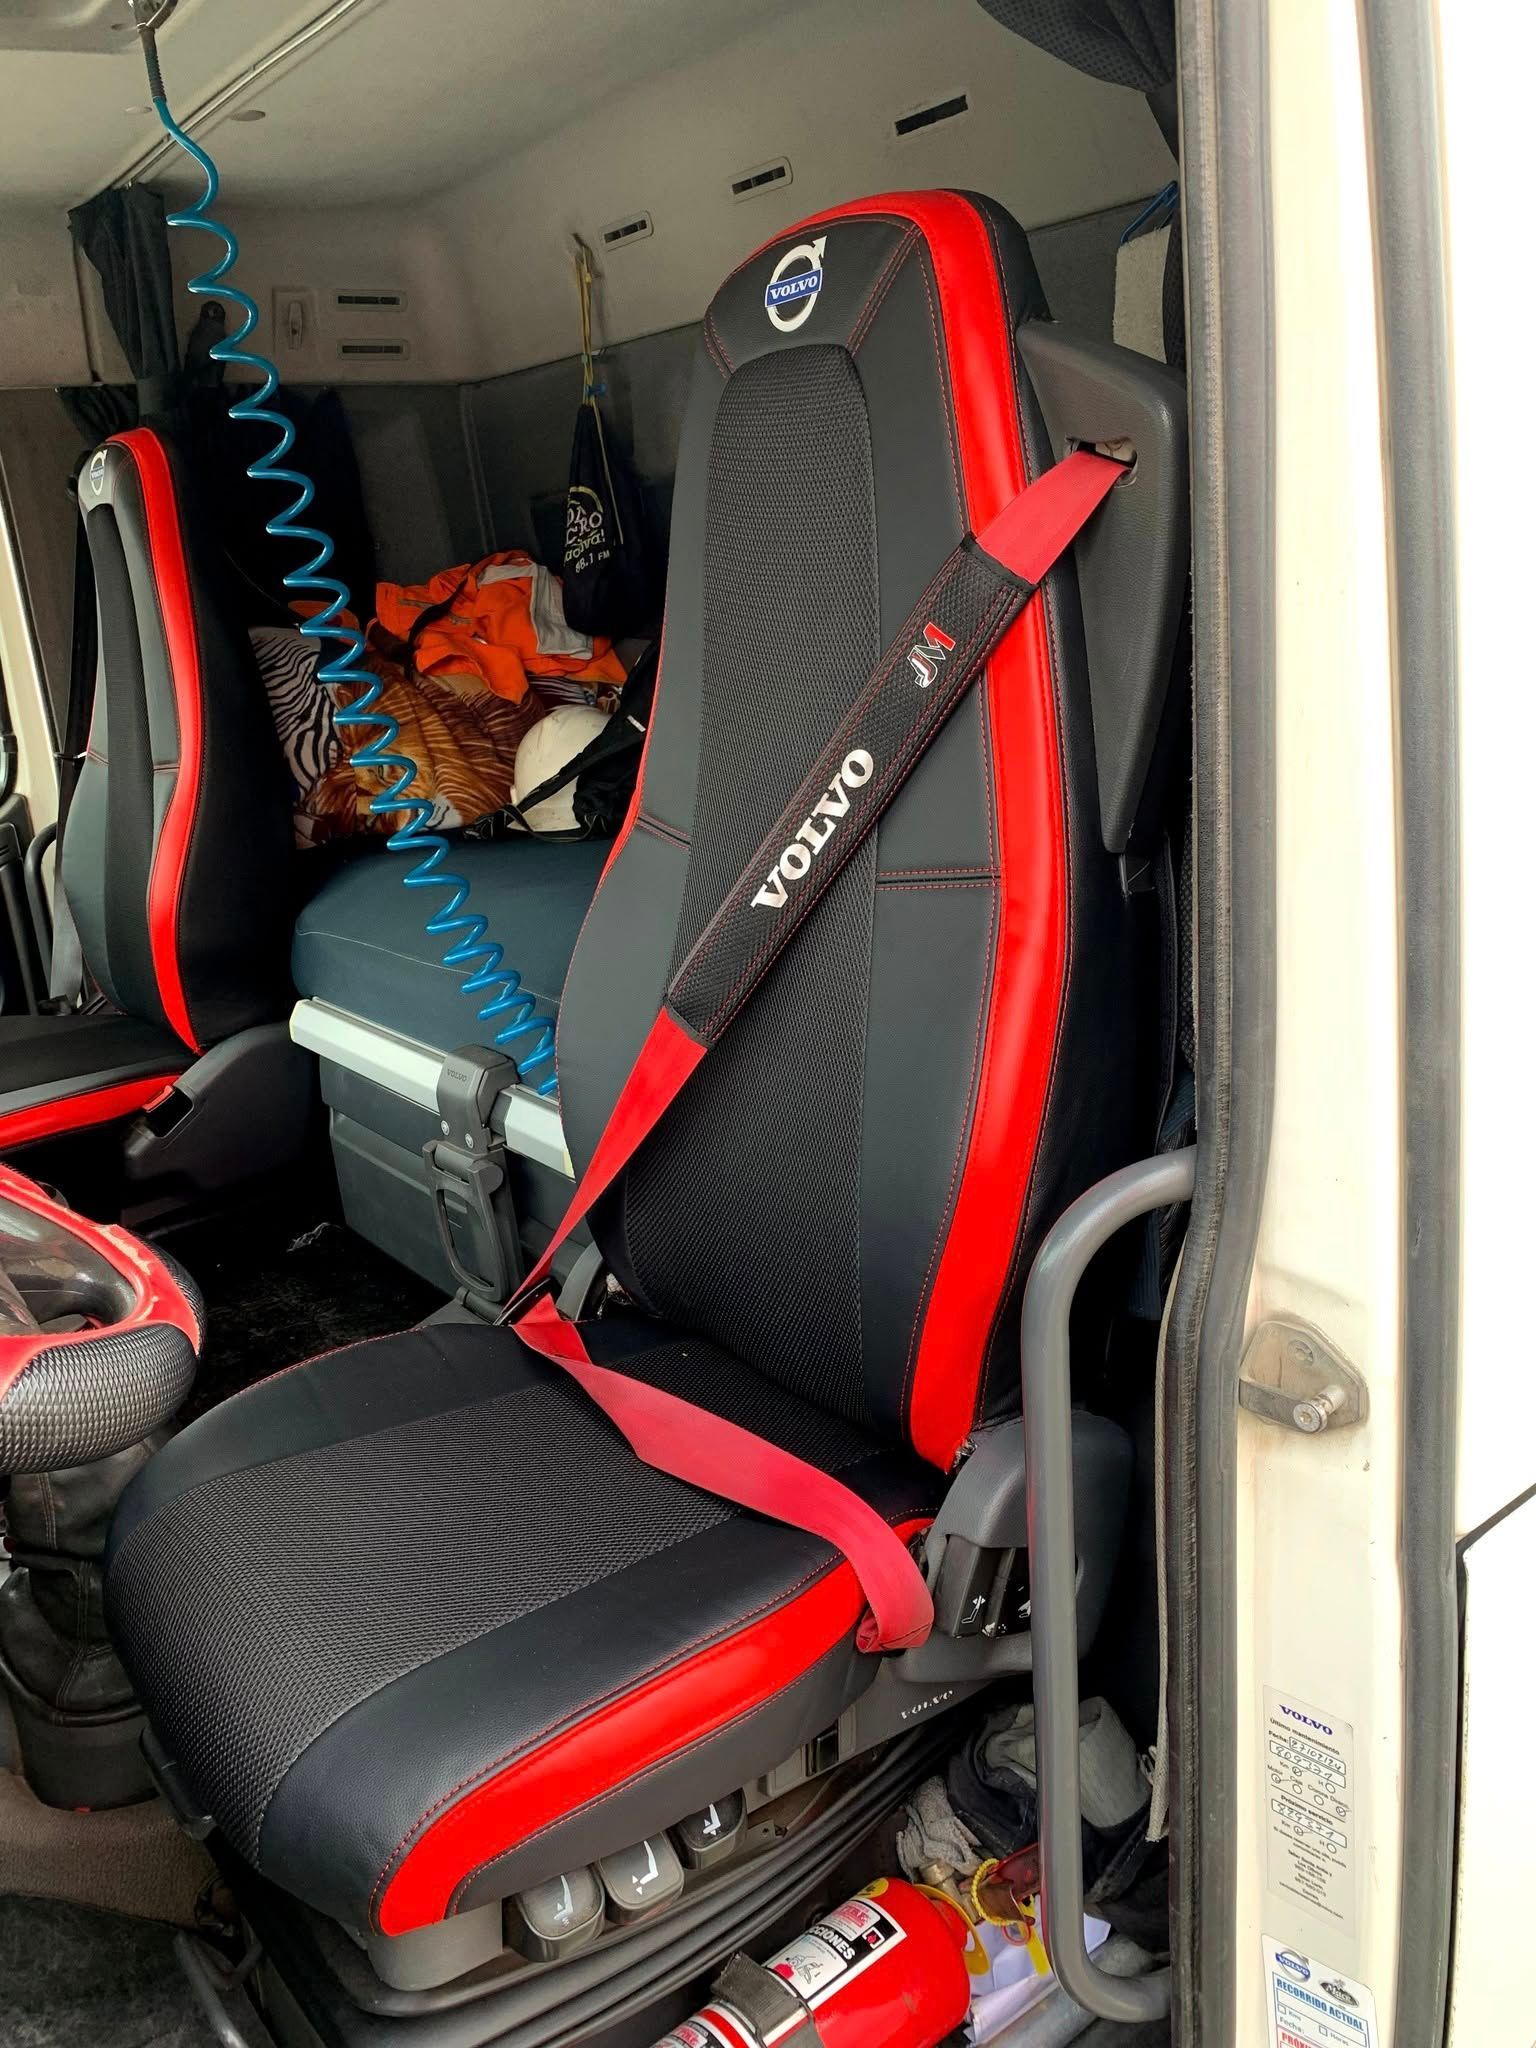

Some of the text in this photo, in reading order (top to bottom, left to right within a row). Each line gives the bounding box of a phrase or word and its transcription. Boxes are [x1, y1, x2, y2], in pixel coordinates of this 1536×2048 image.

[770, 275, 818, 300] VOLVO
[598, 550, 611, 561] FM
[750, 748, 875, 910] VOLVO
[447, 1068, 468, 1083] VOLVO
[1279, 1704, 1334, 1736] VOLVO
[1291, 1728, 1341, 1756] mantenimiento
[1308, 1809, 1334, 1827] servicio
[1279, 1954, 1310, 1977] VOLVO
[1276, 1978, 1364, 2032] RECORRIDO ACTUAL
[1279, 2016, 1305, 2034] Fecha:
